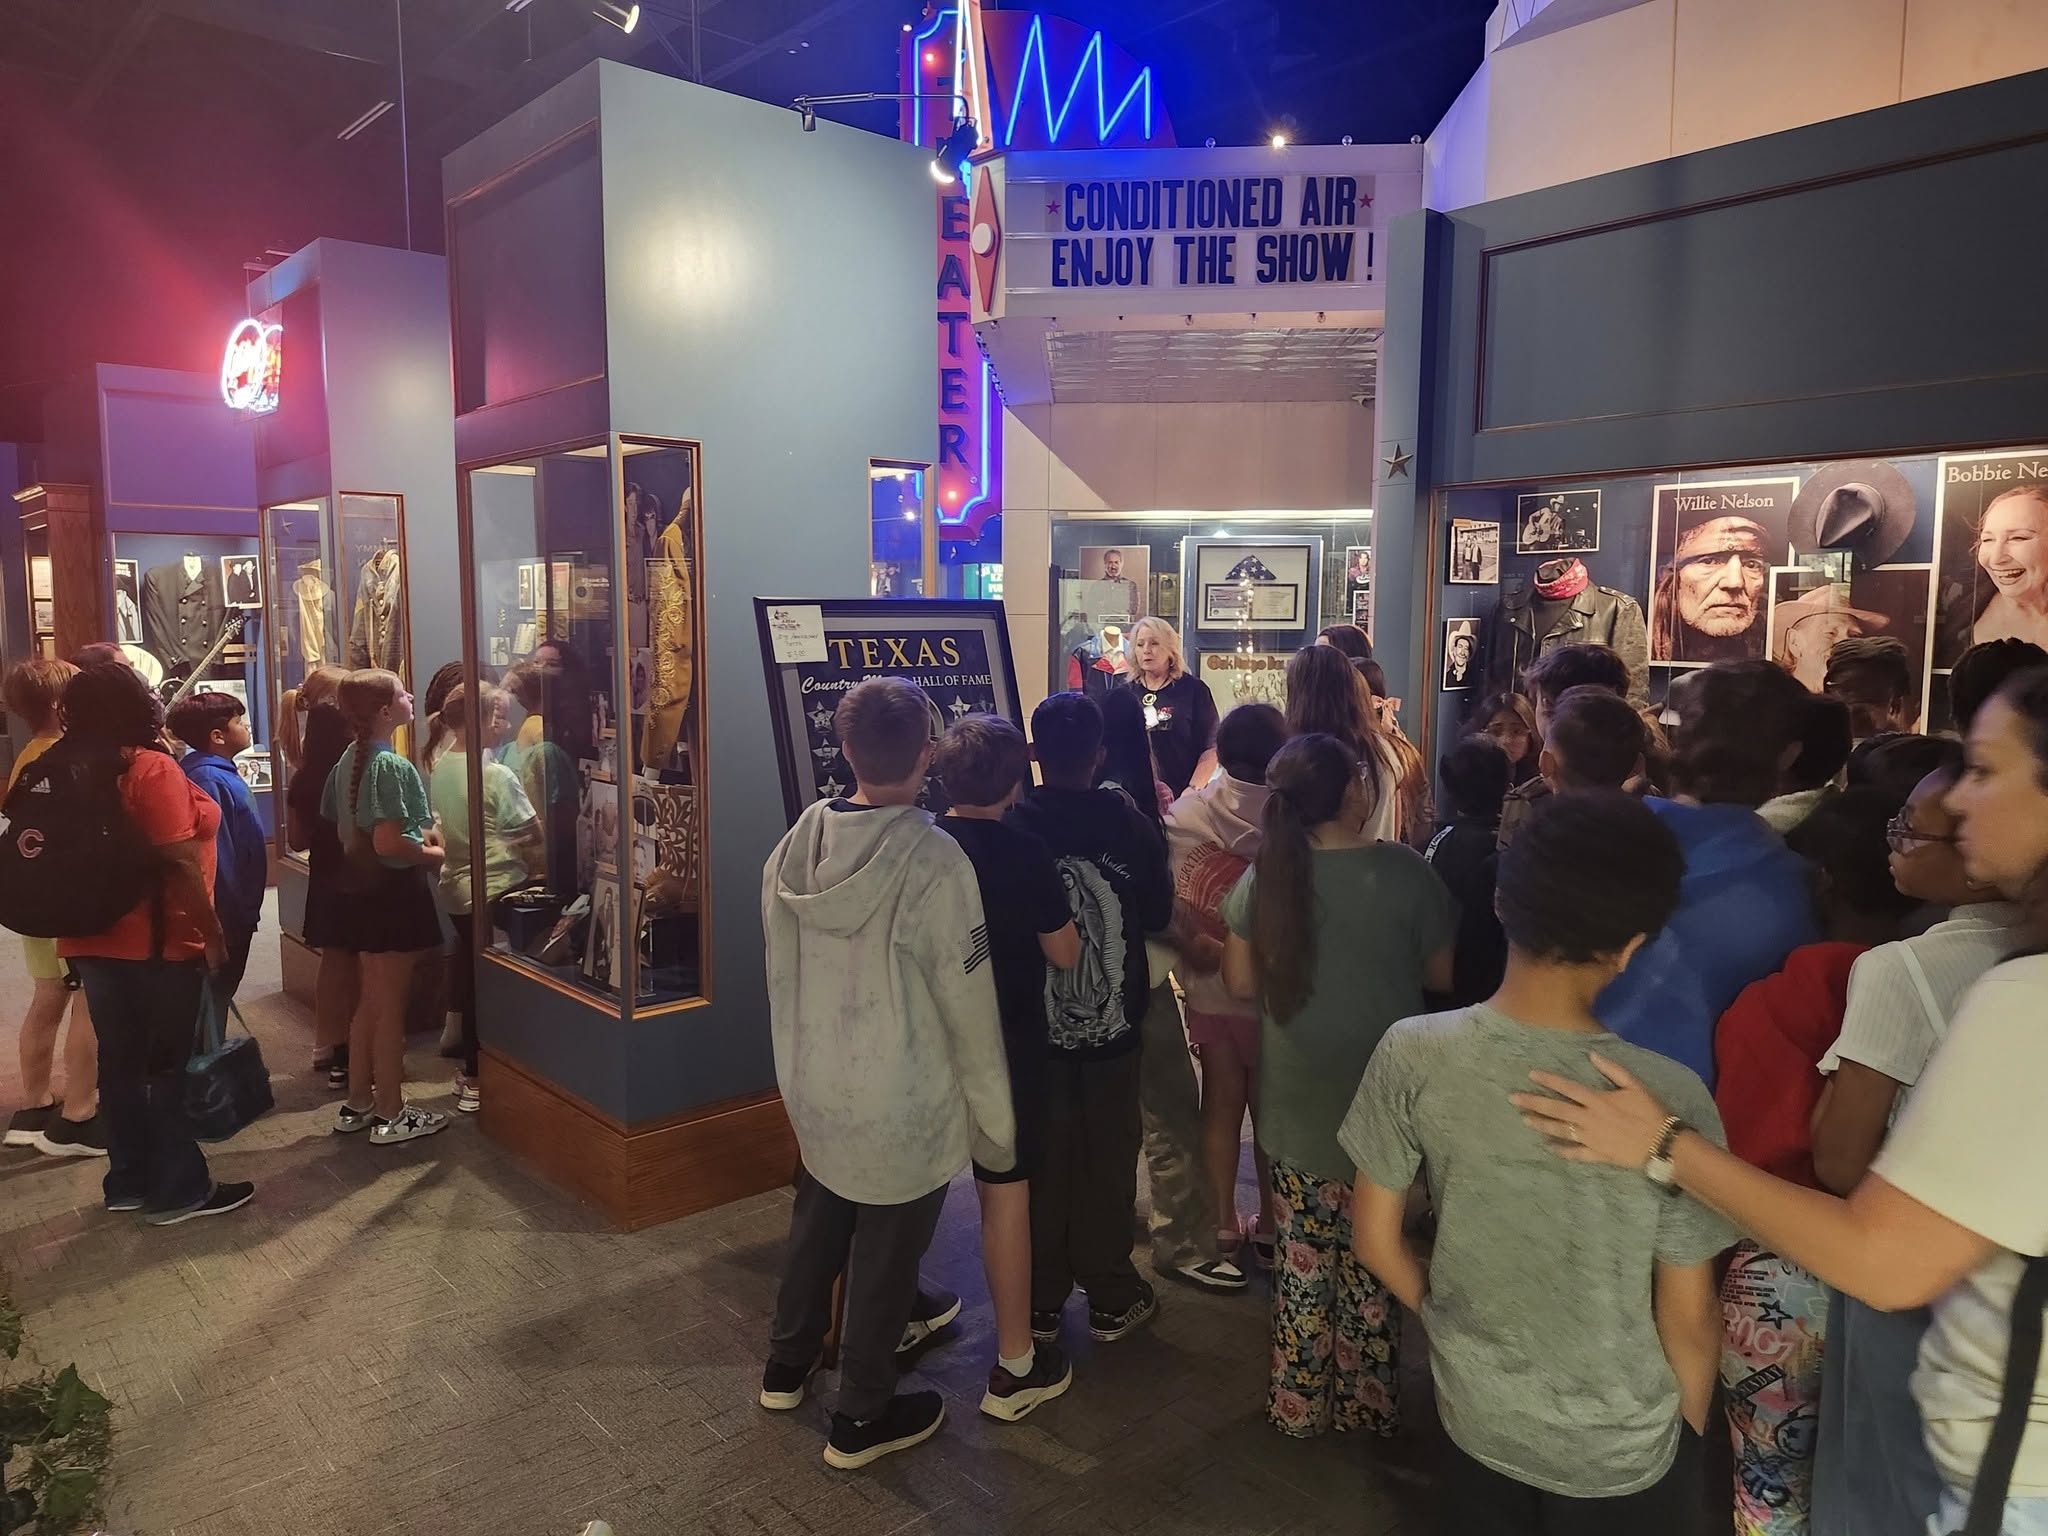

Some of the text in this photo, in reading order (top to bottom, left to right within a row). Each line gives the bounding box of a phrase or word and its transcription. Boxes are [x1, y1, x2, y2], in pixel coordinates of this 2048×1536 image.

[1065, 176, 1358, 231] CONDITIONED AIR
[1052, 236, 1154, 287] ENJOY
[1174, 235, 1236, 285] THE
[1256, 232, 1354, 283] SHOW
[1947, 463, 2012, 483] Bobbie
[1674, 492, 1774, 511] Willie Nelson
[828, 637, 961, 669] TEXAS
[801, 676, 860, 694] Country
[913, 675, 943, 688] HALL
[945, 676, 960, 686] OF
[962, 674, 992, 686] FAME
